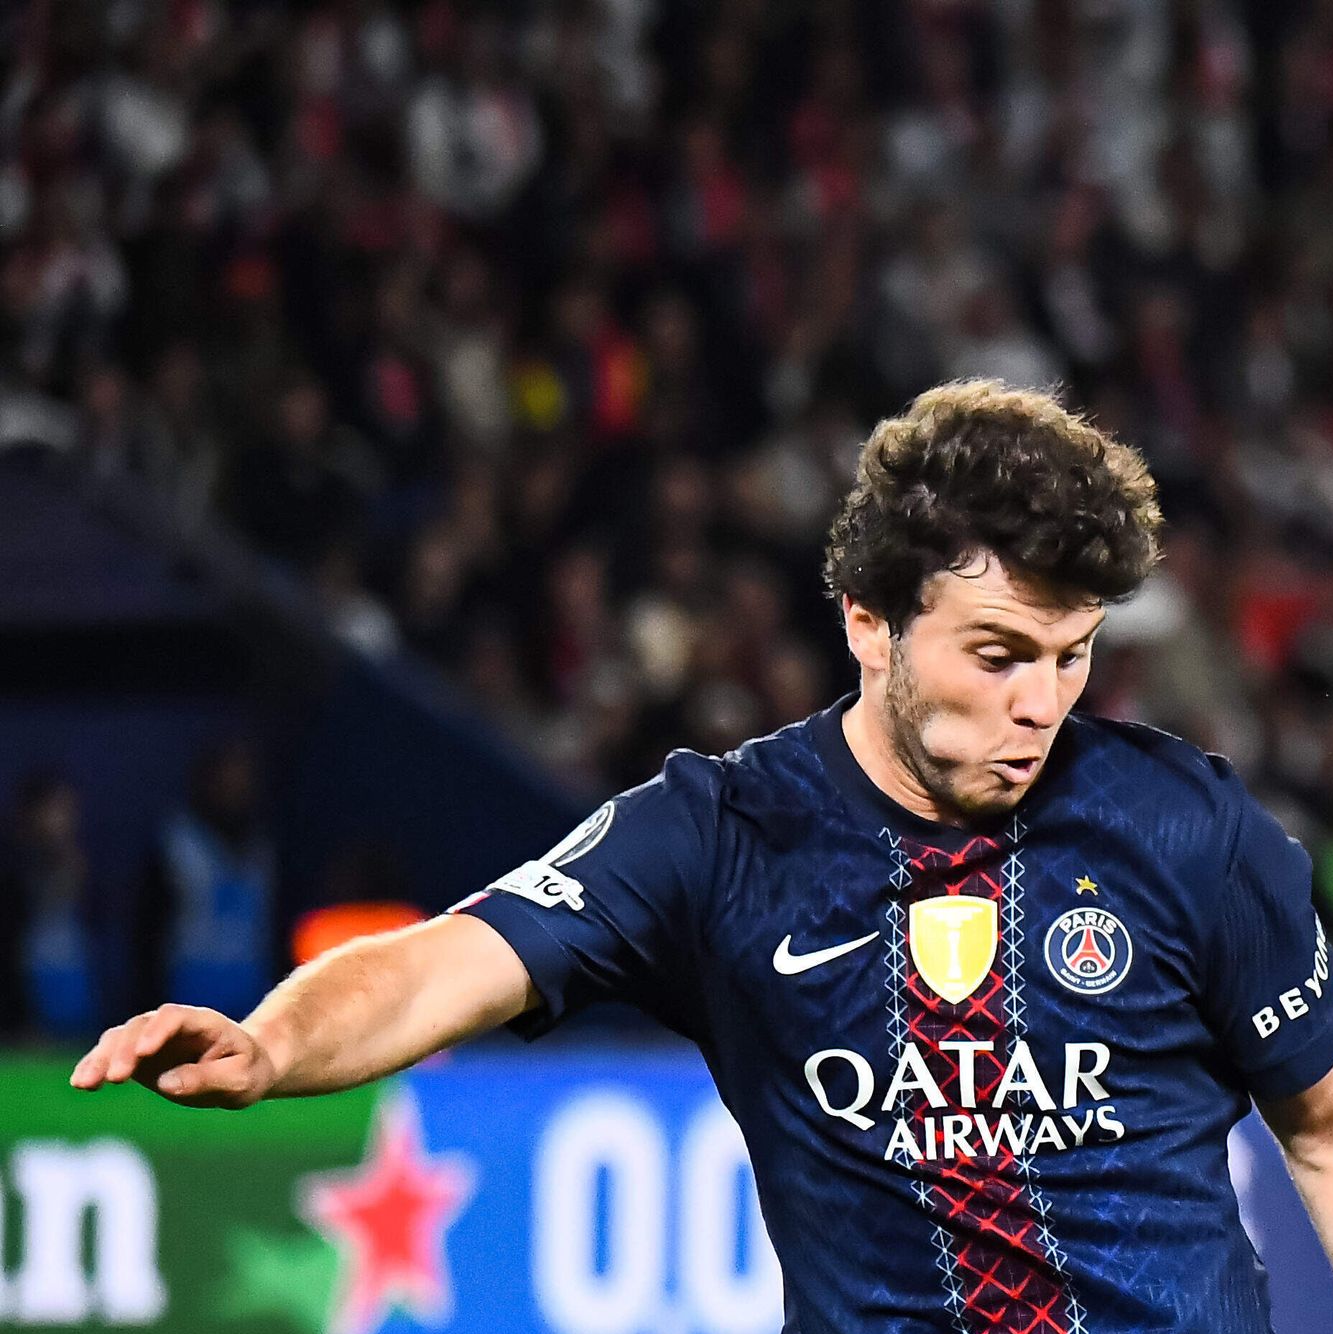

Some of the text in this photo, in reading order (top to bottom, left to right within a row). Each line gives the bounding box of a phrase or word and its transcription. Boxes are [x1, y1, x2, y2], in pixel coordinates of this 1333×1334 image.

[1059, 911, 1118, 935] PARIS
[804, 1041, 1110, 1131] QATAR
[884, 1105, 1126, 1161] AIRWAYS
